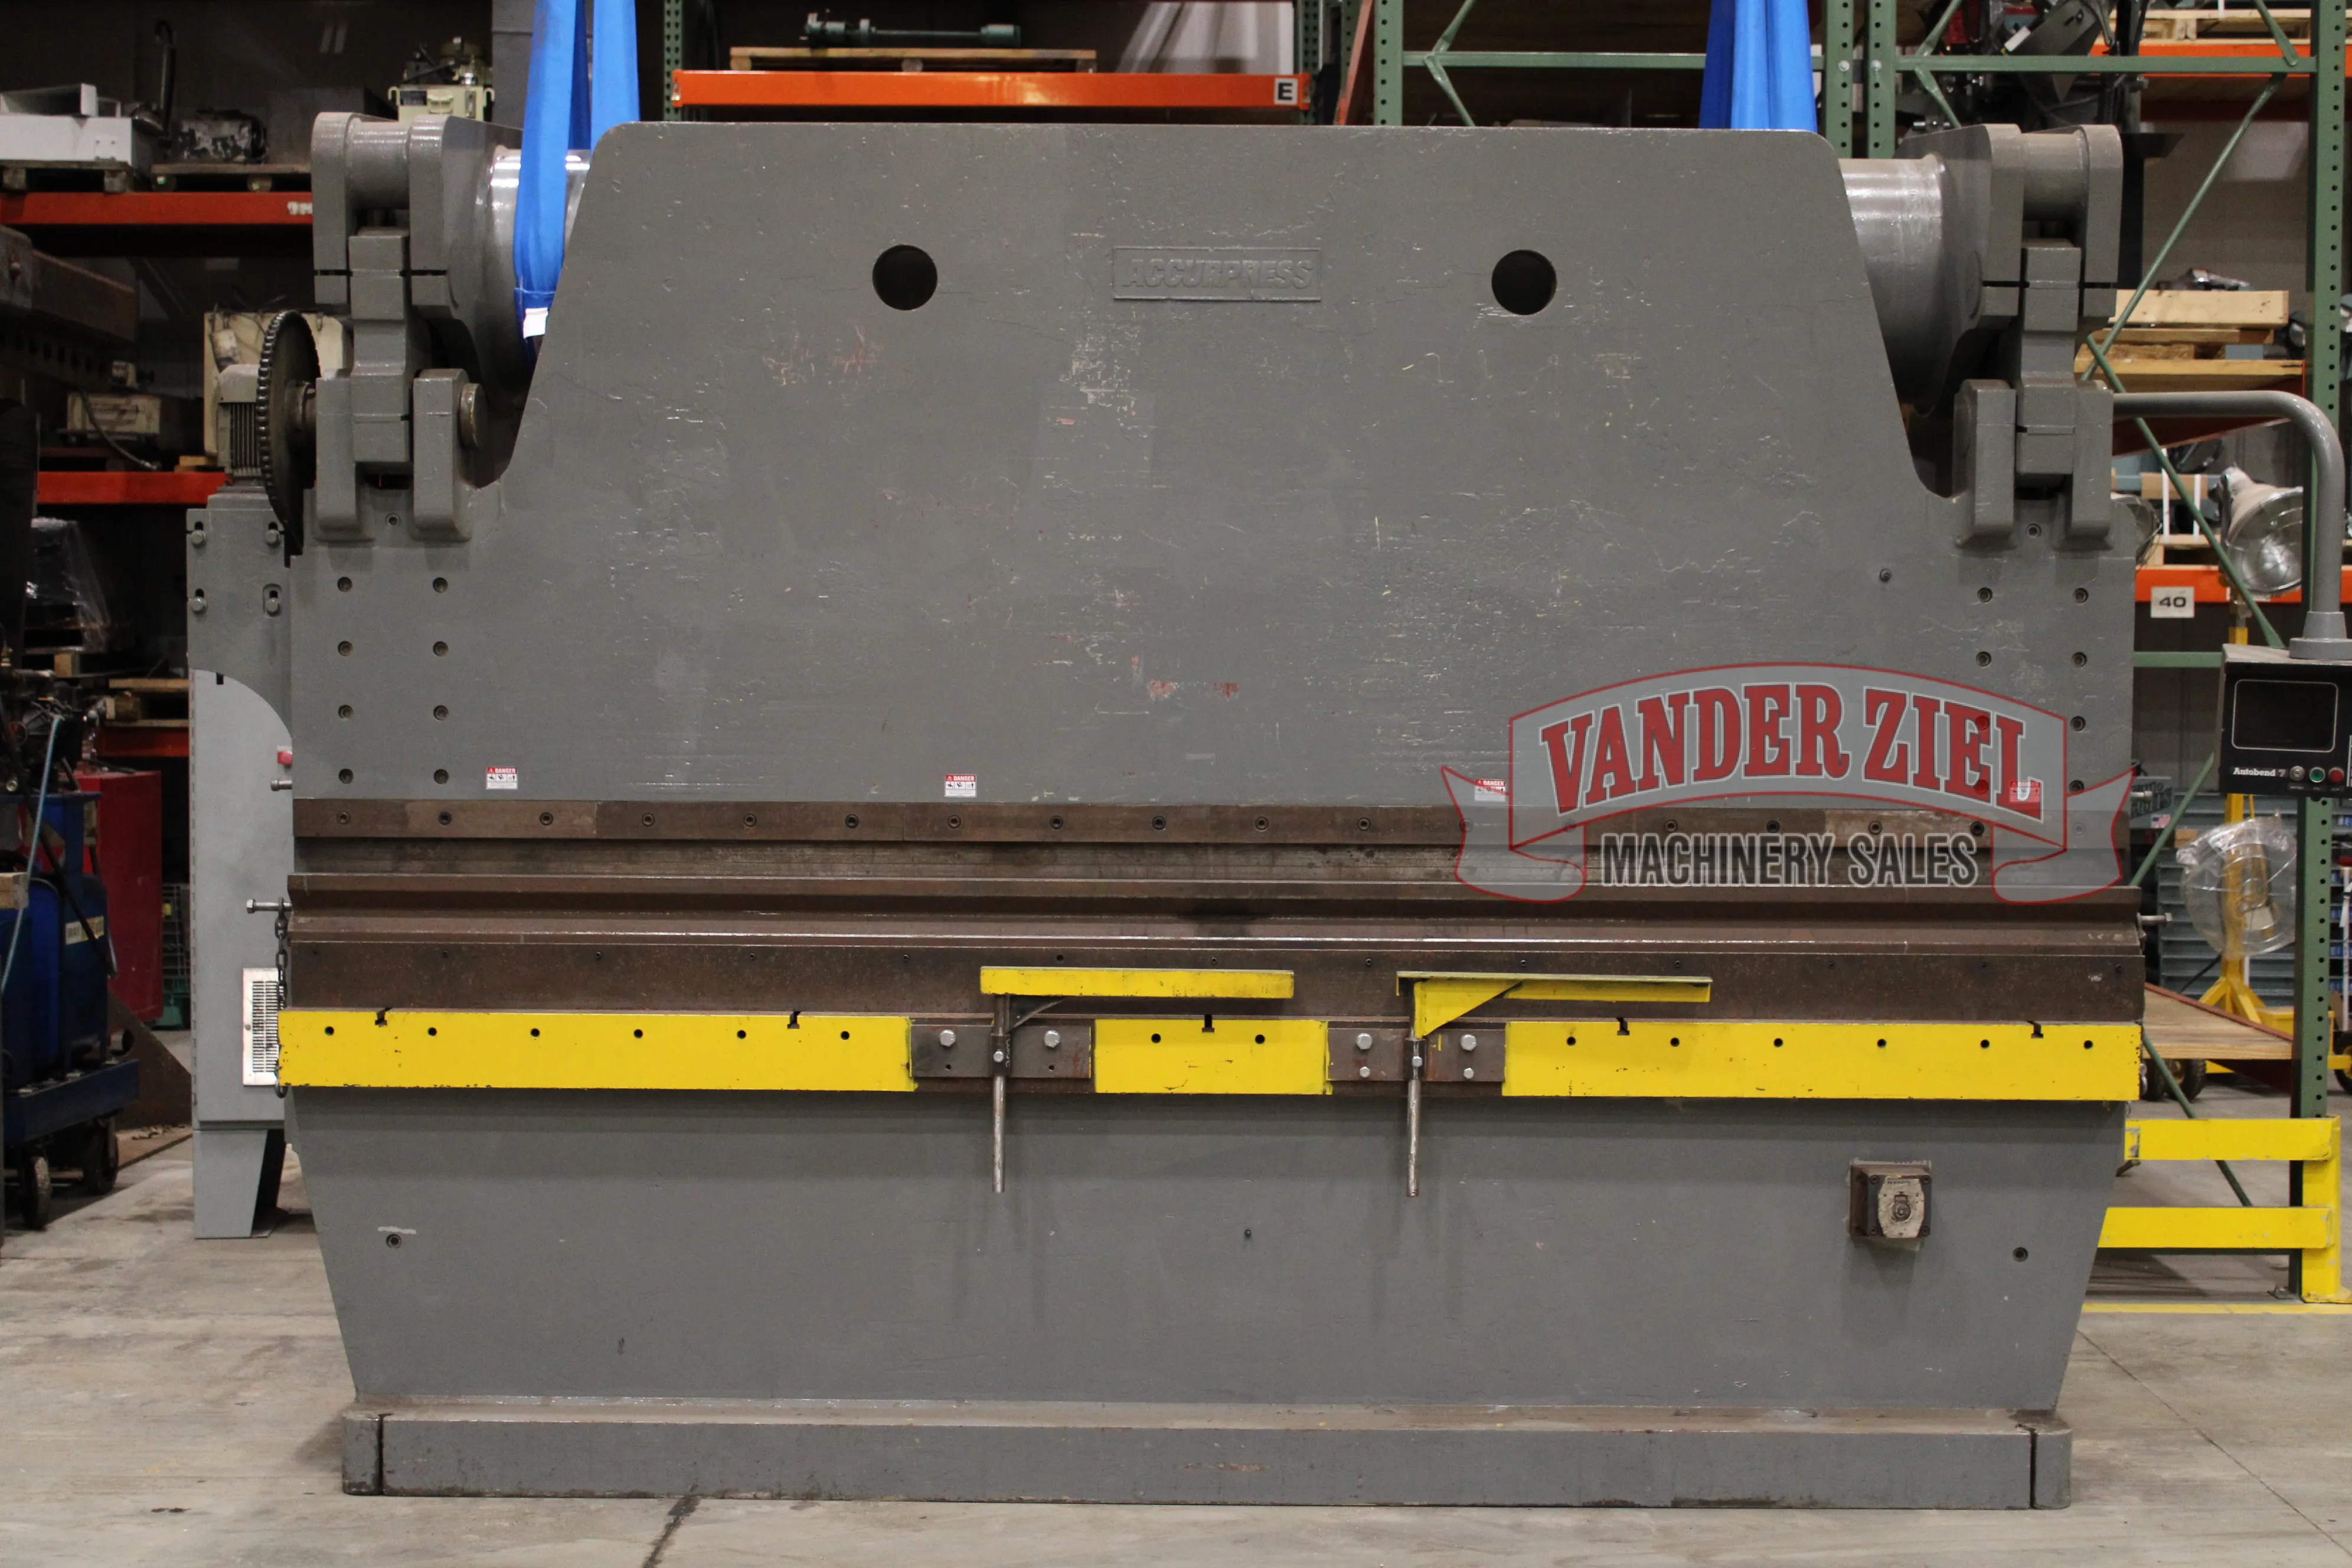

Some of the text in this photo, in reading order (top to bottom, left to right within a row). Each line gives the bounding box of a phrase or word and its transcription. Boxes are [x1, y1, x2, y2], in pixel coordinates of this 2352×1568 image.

[1278, 82, 1292, 100] E
[2160, 597, 2186, 607] 40
[2233, 767, 2286, 777] Autobend 7
